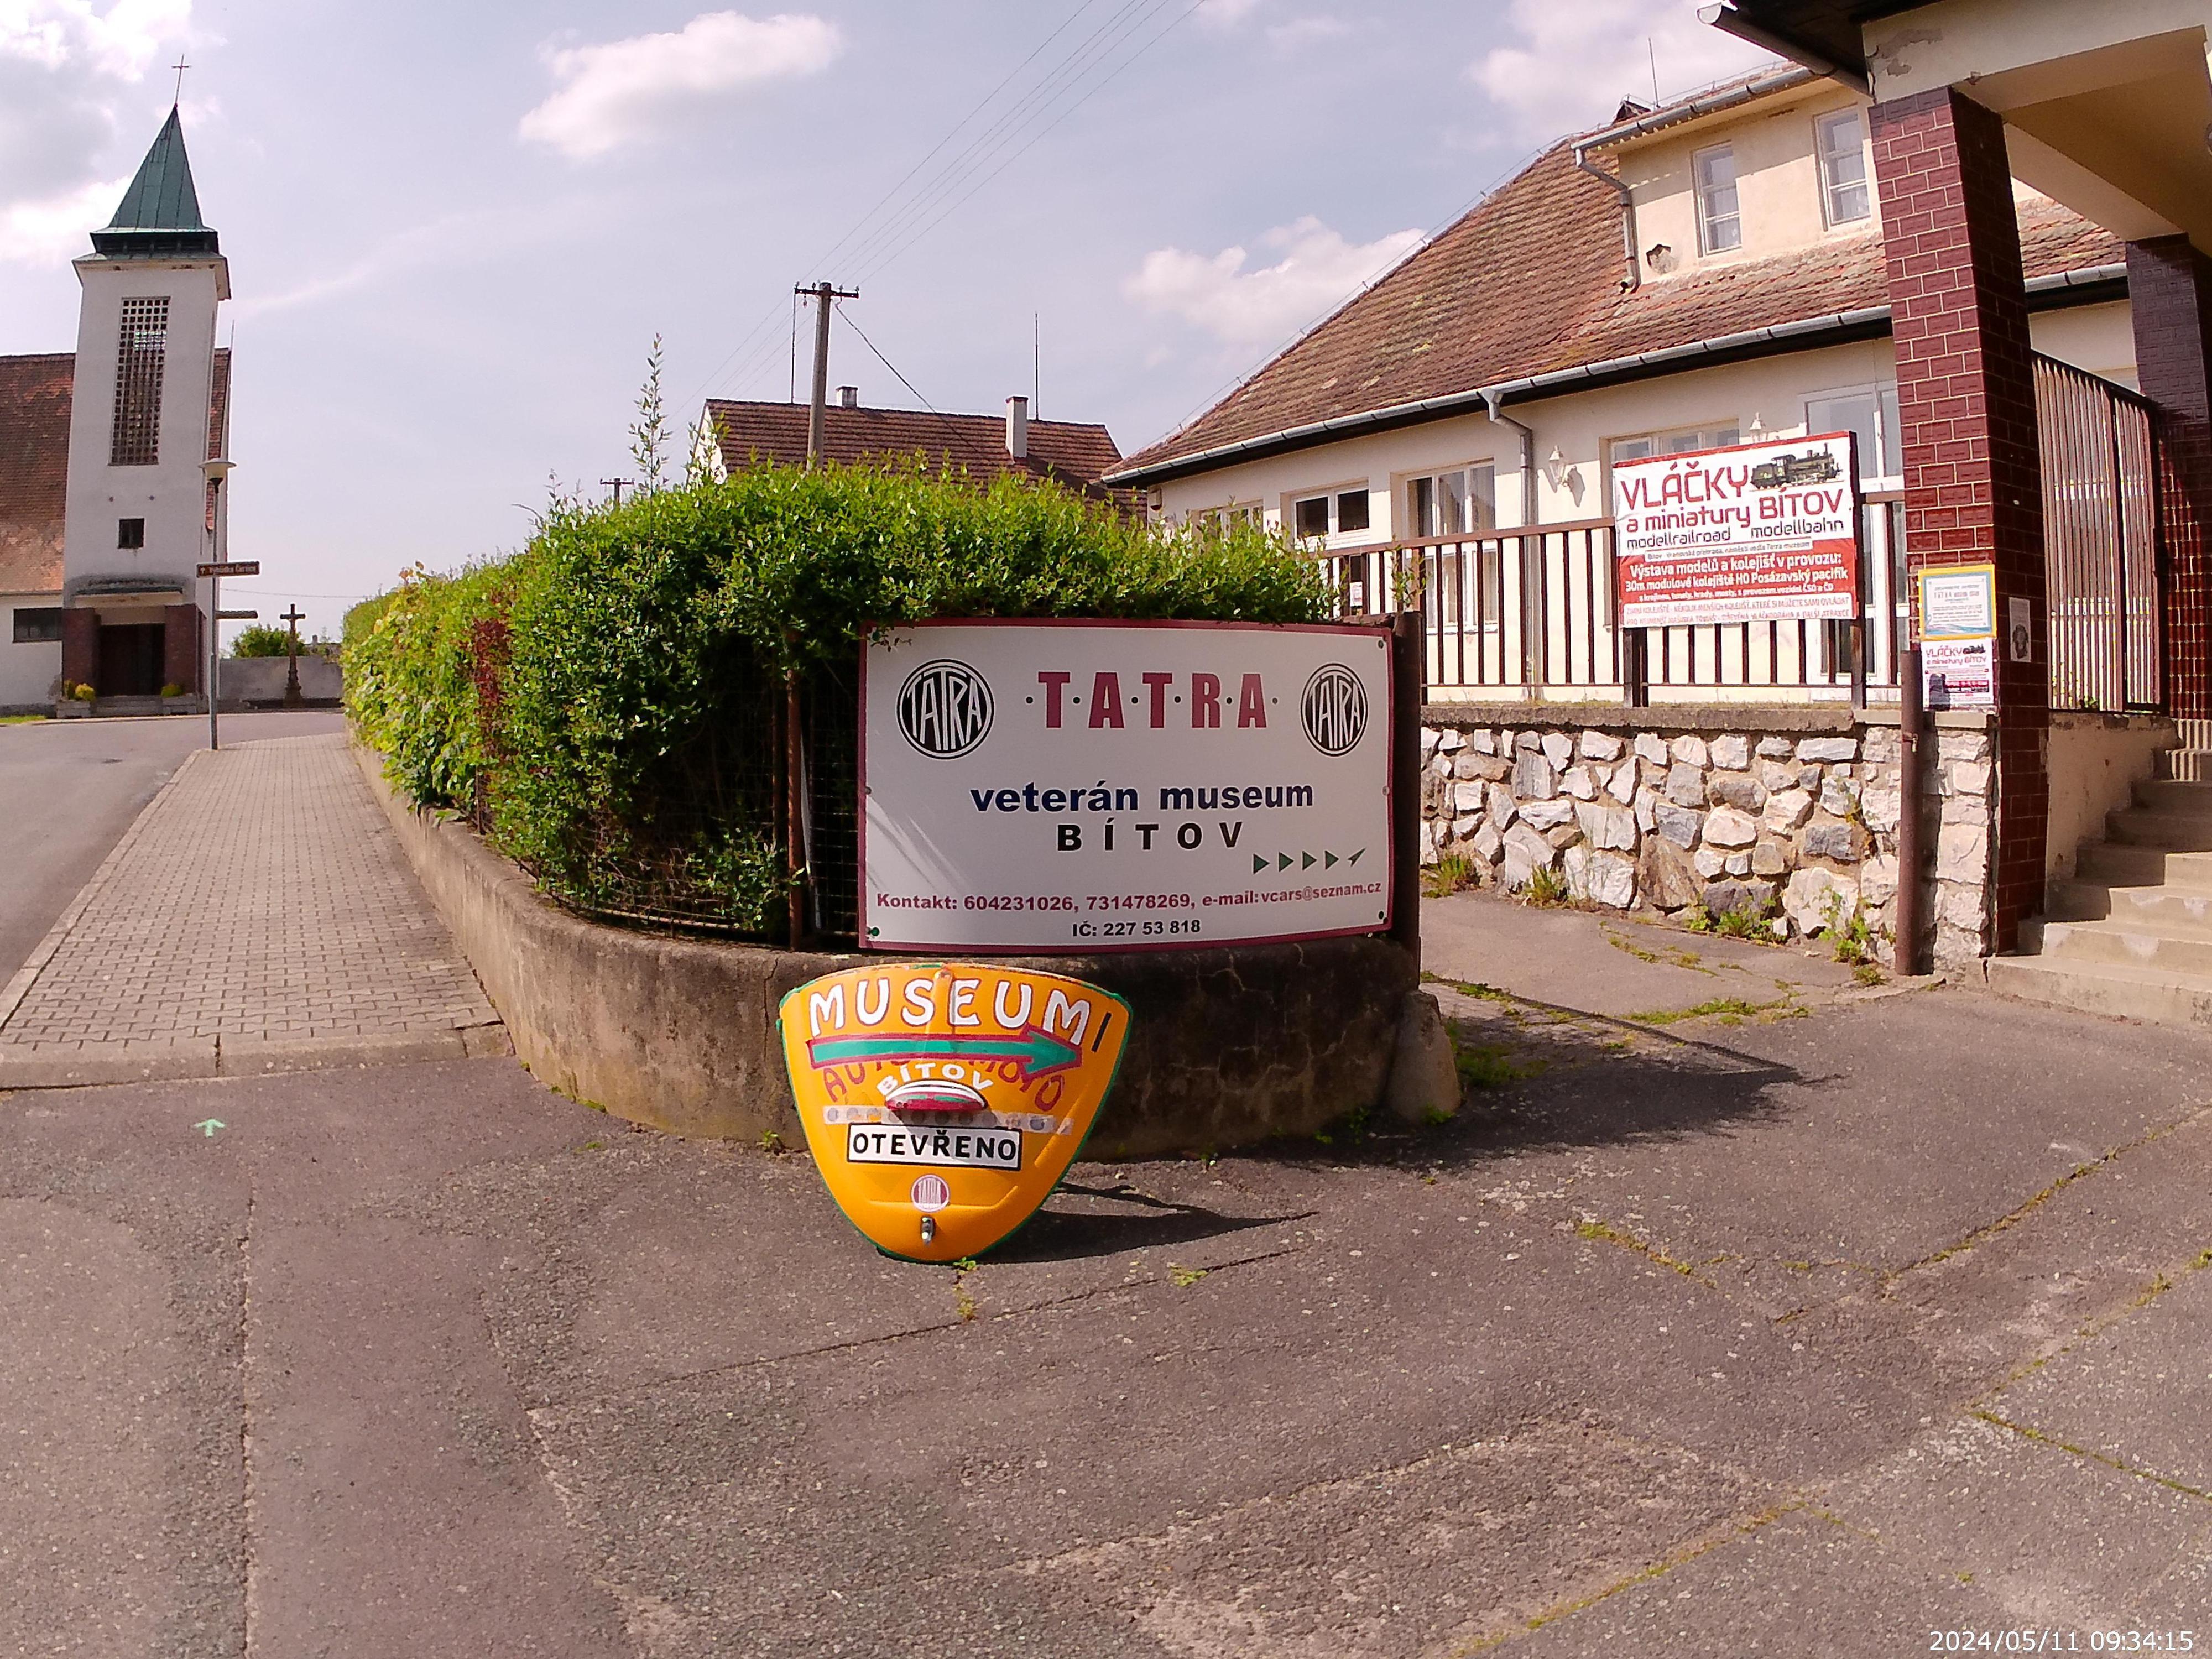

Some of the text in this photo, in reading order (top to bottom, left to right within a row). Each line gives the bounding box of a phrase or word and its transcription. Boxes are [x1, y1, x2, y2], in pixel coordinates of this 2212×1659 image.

[1620, 461, 1748, 510] VLÁČKY
[1626, 487, 1843, 533] a miniatury BÍTOV
[1627, 517, 1844, 550] modellrailroad modellbahn
[1630, 563, 1674, 580] Výstava
[1676, 558, 1719, 574] modelů
[1721, 562, 1729, 572] a
[1730, 553, 1776, 572] kolejišť
[1776, 557, 1785, 567] v
[1647, 576, 1692, 591] modulové
[1693, 572, 1734, 588] kolejiště
[1751, 568, 1811, 584] Posázavský
[1812, 566, 1849, 582] pacifik
[907, 667, 983, 751] TATRA
[1308, 670, 1361, 749] TATRA
[971, 780, 1313, 812] veterán museum
[1057, 818, 1243, 852] BÍTOV
[877, 881, 1382, 913] Kontakt: 604231026, 731478269, e-mail: vcars@seznam.cz
[1072, 919, 1201, 937] IČ: 227 53 818
[810, 977, 1092, 1046] MUSEUM
[877, 1063, 994, 1096] BÍTOV
[852, 1129, 1016, 1161] OTEVŘENO
